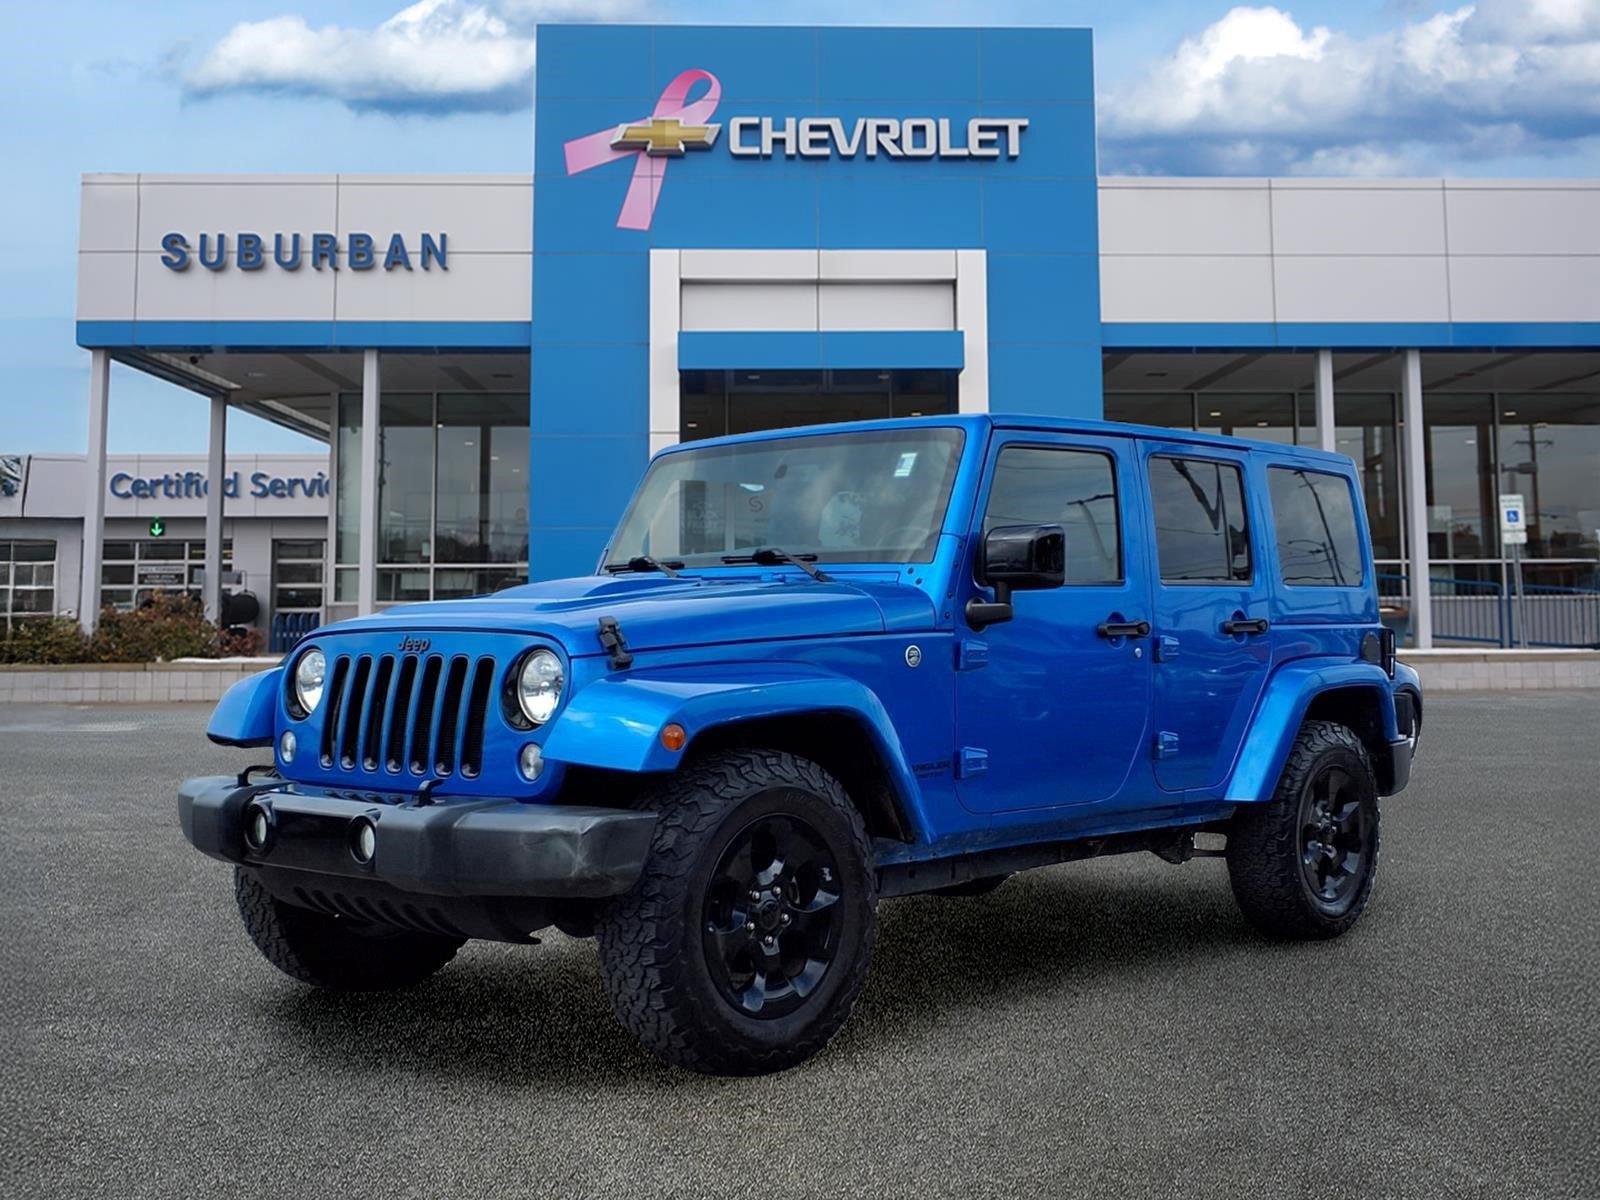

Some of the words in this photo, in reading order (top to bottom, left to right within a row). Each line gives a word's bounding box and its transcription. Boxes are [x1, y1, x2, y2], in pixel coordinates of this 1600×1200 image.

[729, 116, 1030, 159] CHEVROLET
[160, 232, 449, 271] SUBURBAN
[110, 471, 240, 498] Certifid
[250, 471, 330, 498] Servi
[397, 634, 431, 654] Jeep
